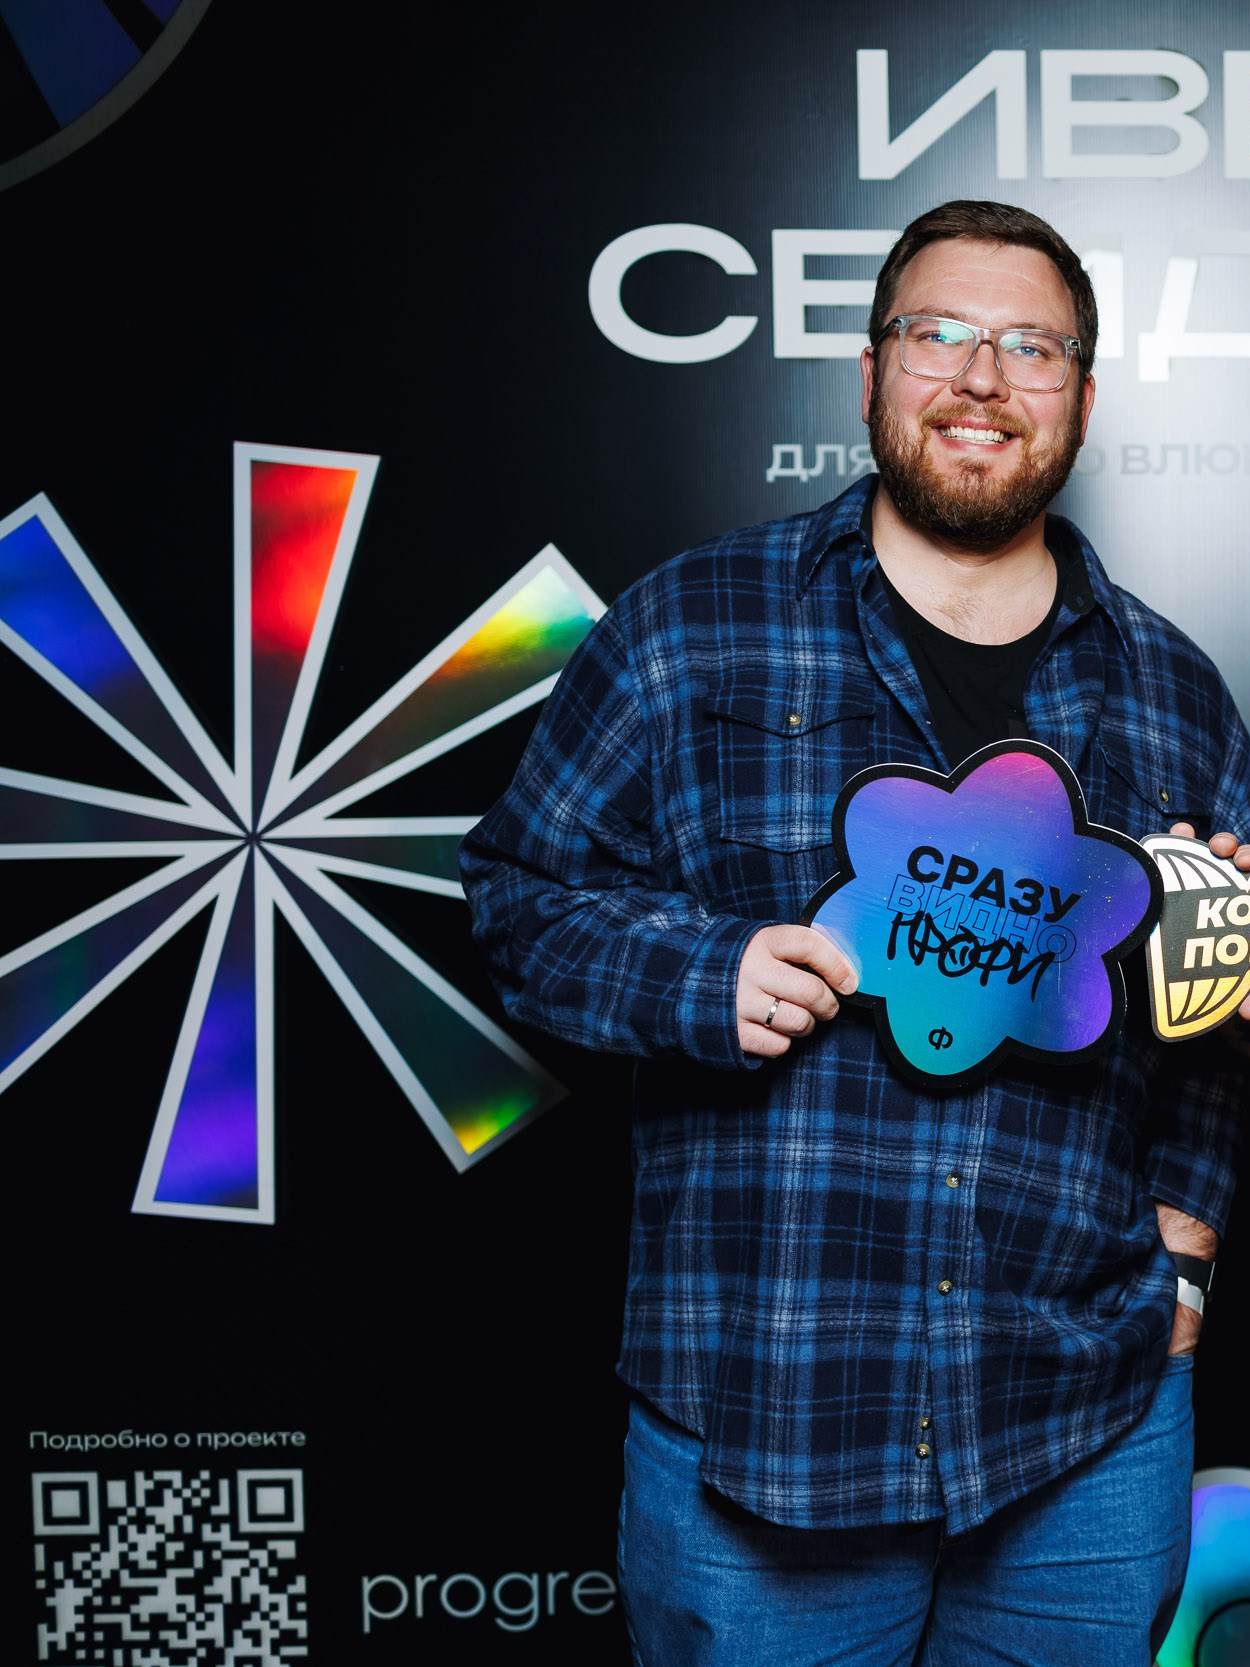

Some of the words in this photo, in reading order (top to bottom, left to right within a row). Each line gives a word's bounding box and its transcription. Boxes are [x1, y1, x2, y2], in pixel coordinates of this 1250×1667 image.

[765, 443, 879, 483] ДЛЯ
[886, 874, 1077, 963] ВИДНО
[907, 846, 1082, 923] СРАЗУ
[886, 911, 1057, 1003] ПРОФИ
[29, 1430, 168, 1452] Подробно
[174, 1434, 191, 1448] о
[199, 1430, 307, 1450] проекте
